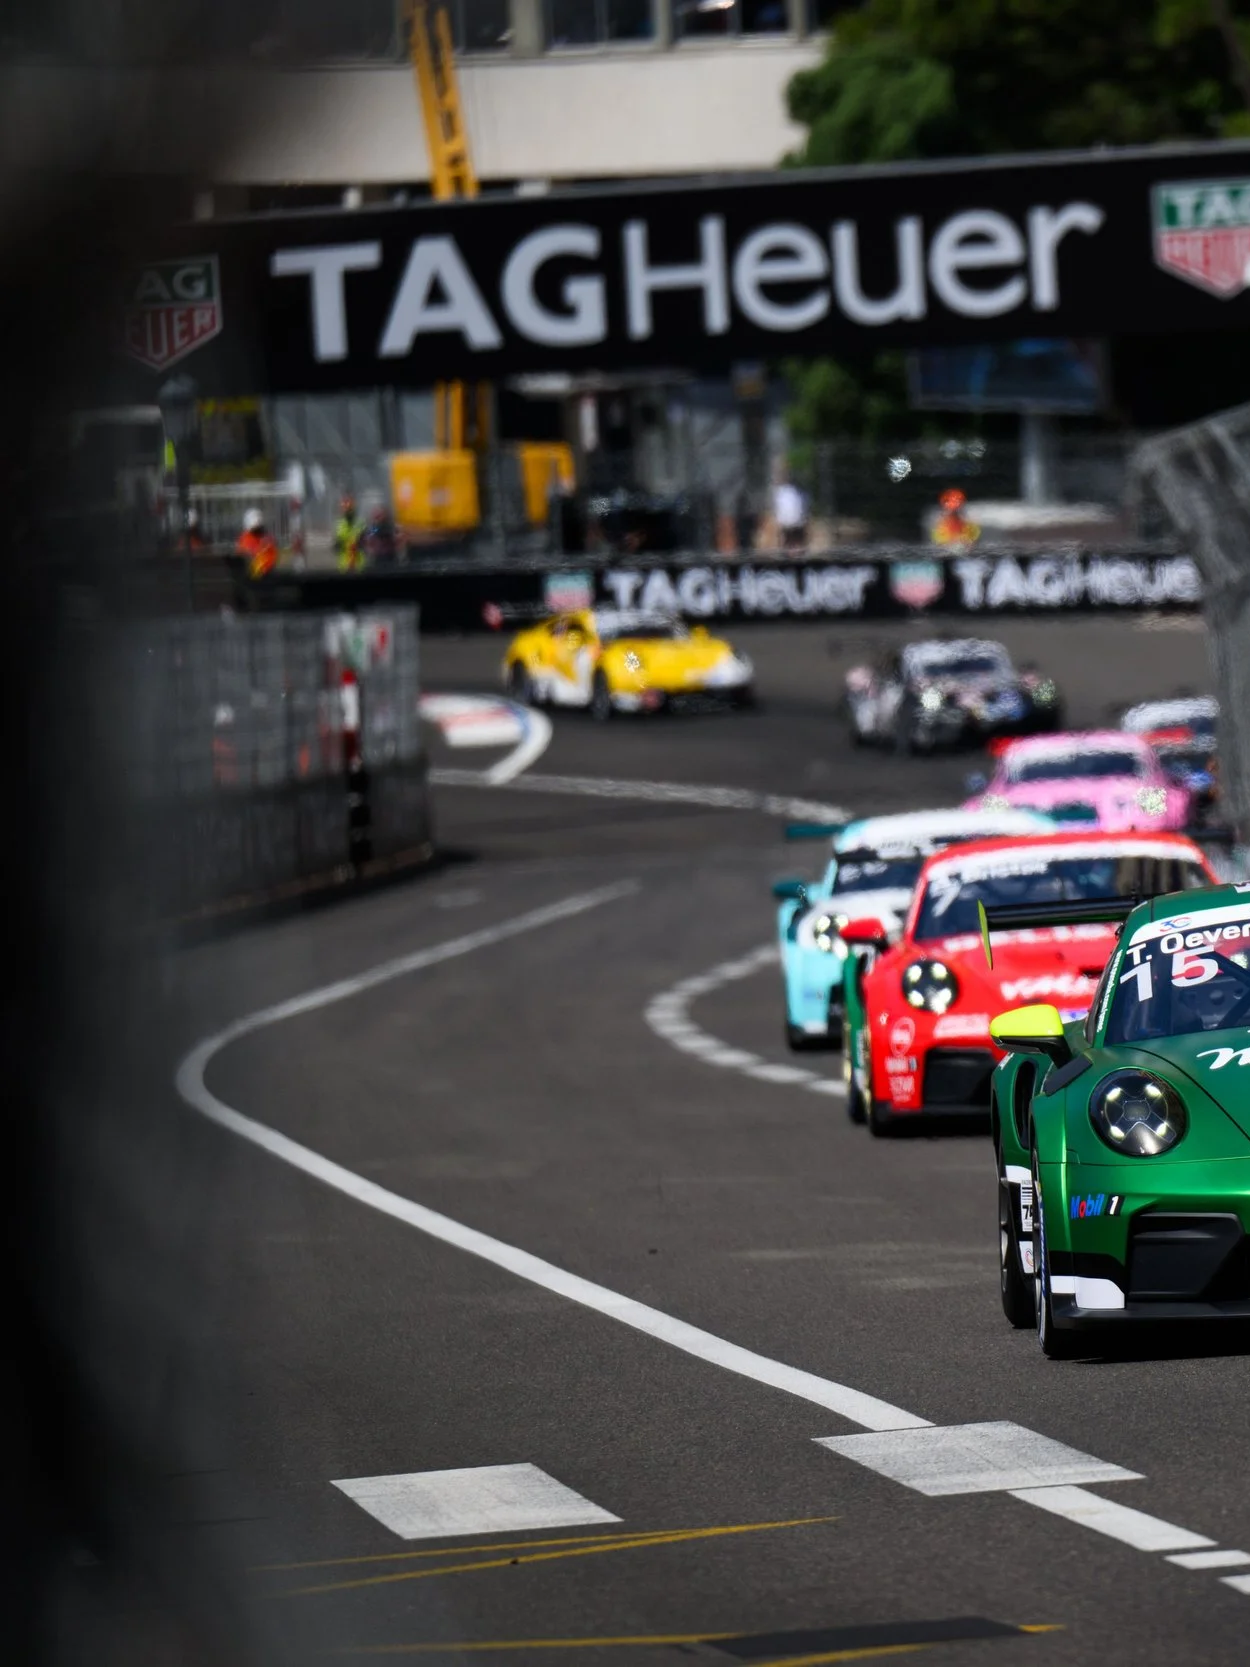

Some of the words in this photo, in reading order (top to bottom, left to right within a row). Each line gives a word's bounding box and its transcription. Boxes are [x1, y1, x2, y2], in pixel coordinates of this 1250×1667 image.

[134, 265, 207, 301] AG
[124, 307, 214, 360] EUER
[1126, 943, 1152, 965] T.
[1119, 945, 1219, 1002] 15
[1070, 1193, 1105, 1219] Mobil
